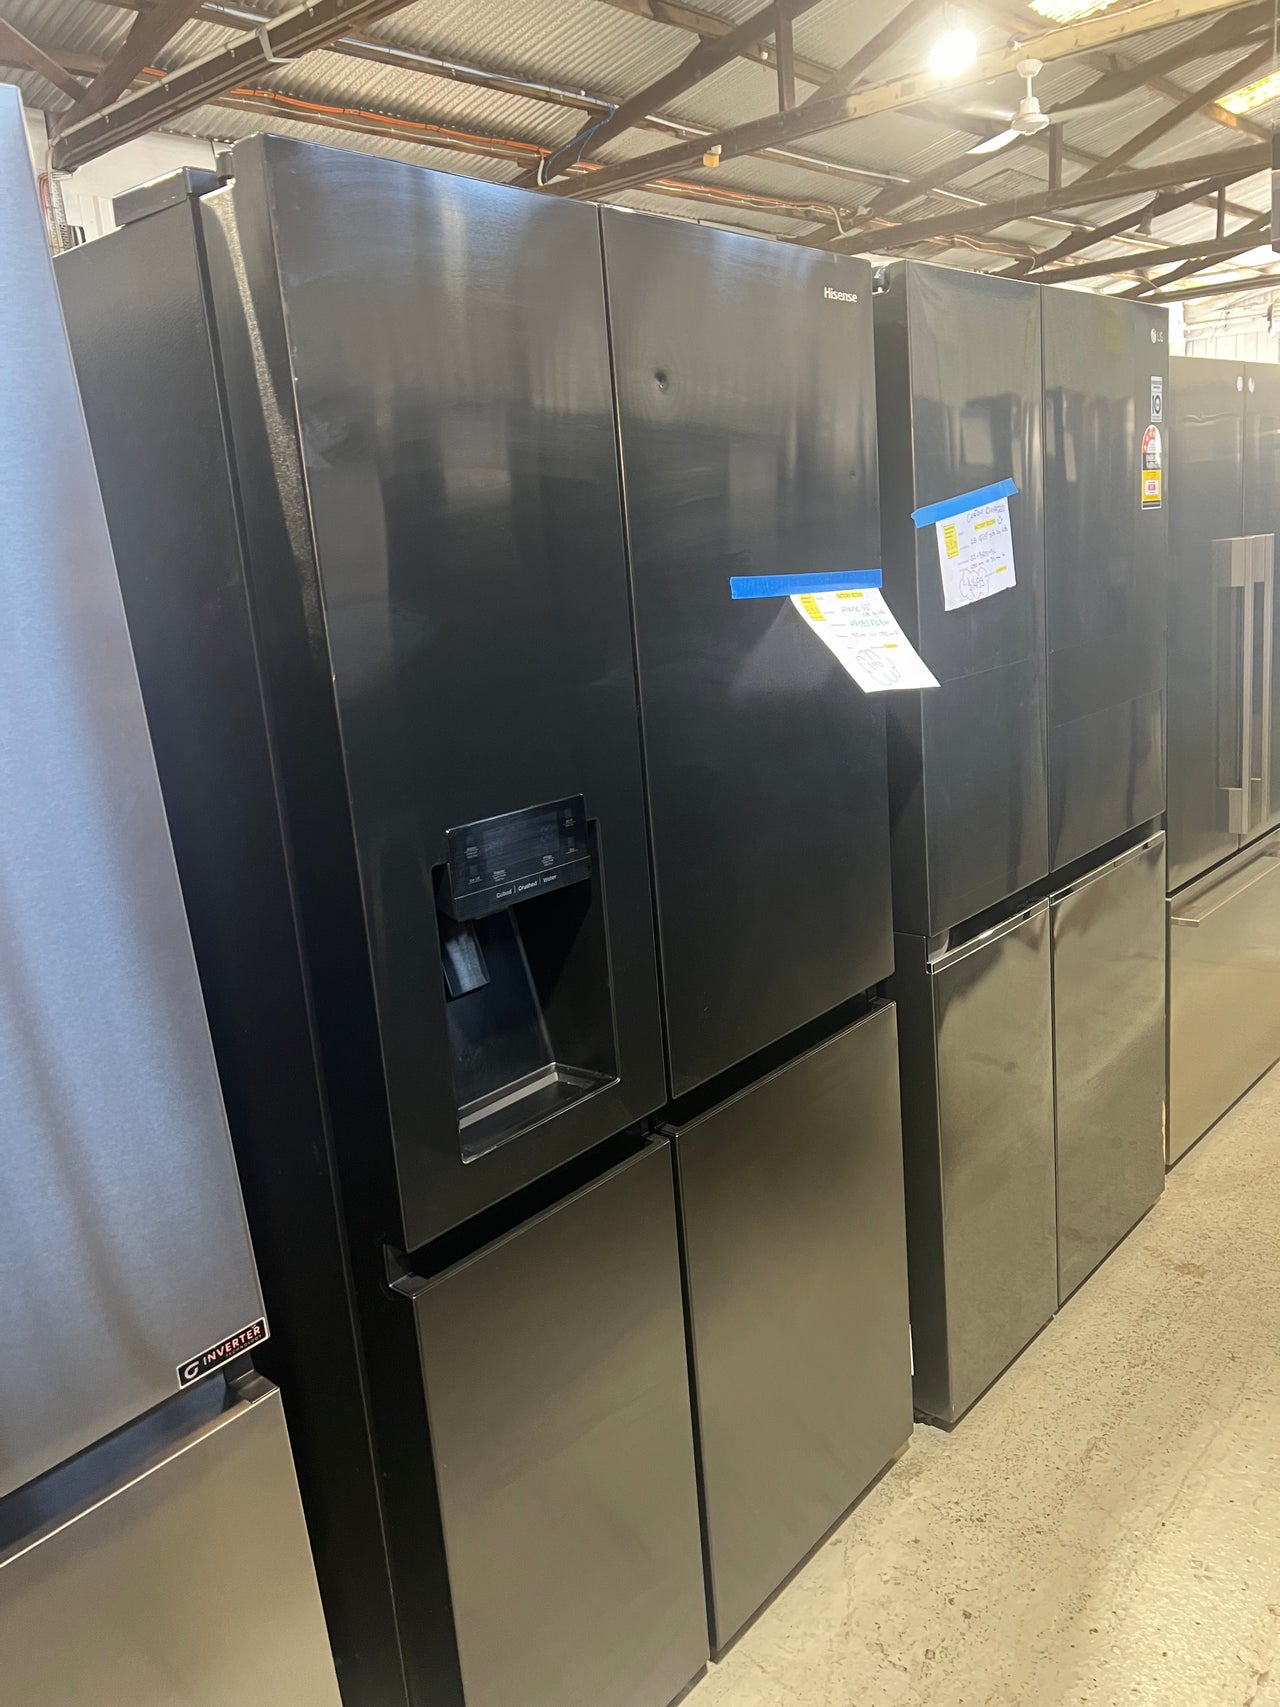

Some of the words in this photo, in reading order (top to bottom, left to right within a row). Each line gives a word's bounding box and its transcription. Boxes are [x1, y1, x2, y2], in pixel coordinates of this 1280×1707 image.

[824, 287, 858, 303] Hisense
[496, 889, 512, 899] Cubed
[517, 880, 538, 892] Crushed
[203, 1325, 262, 1366] INVERTER
